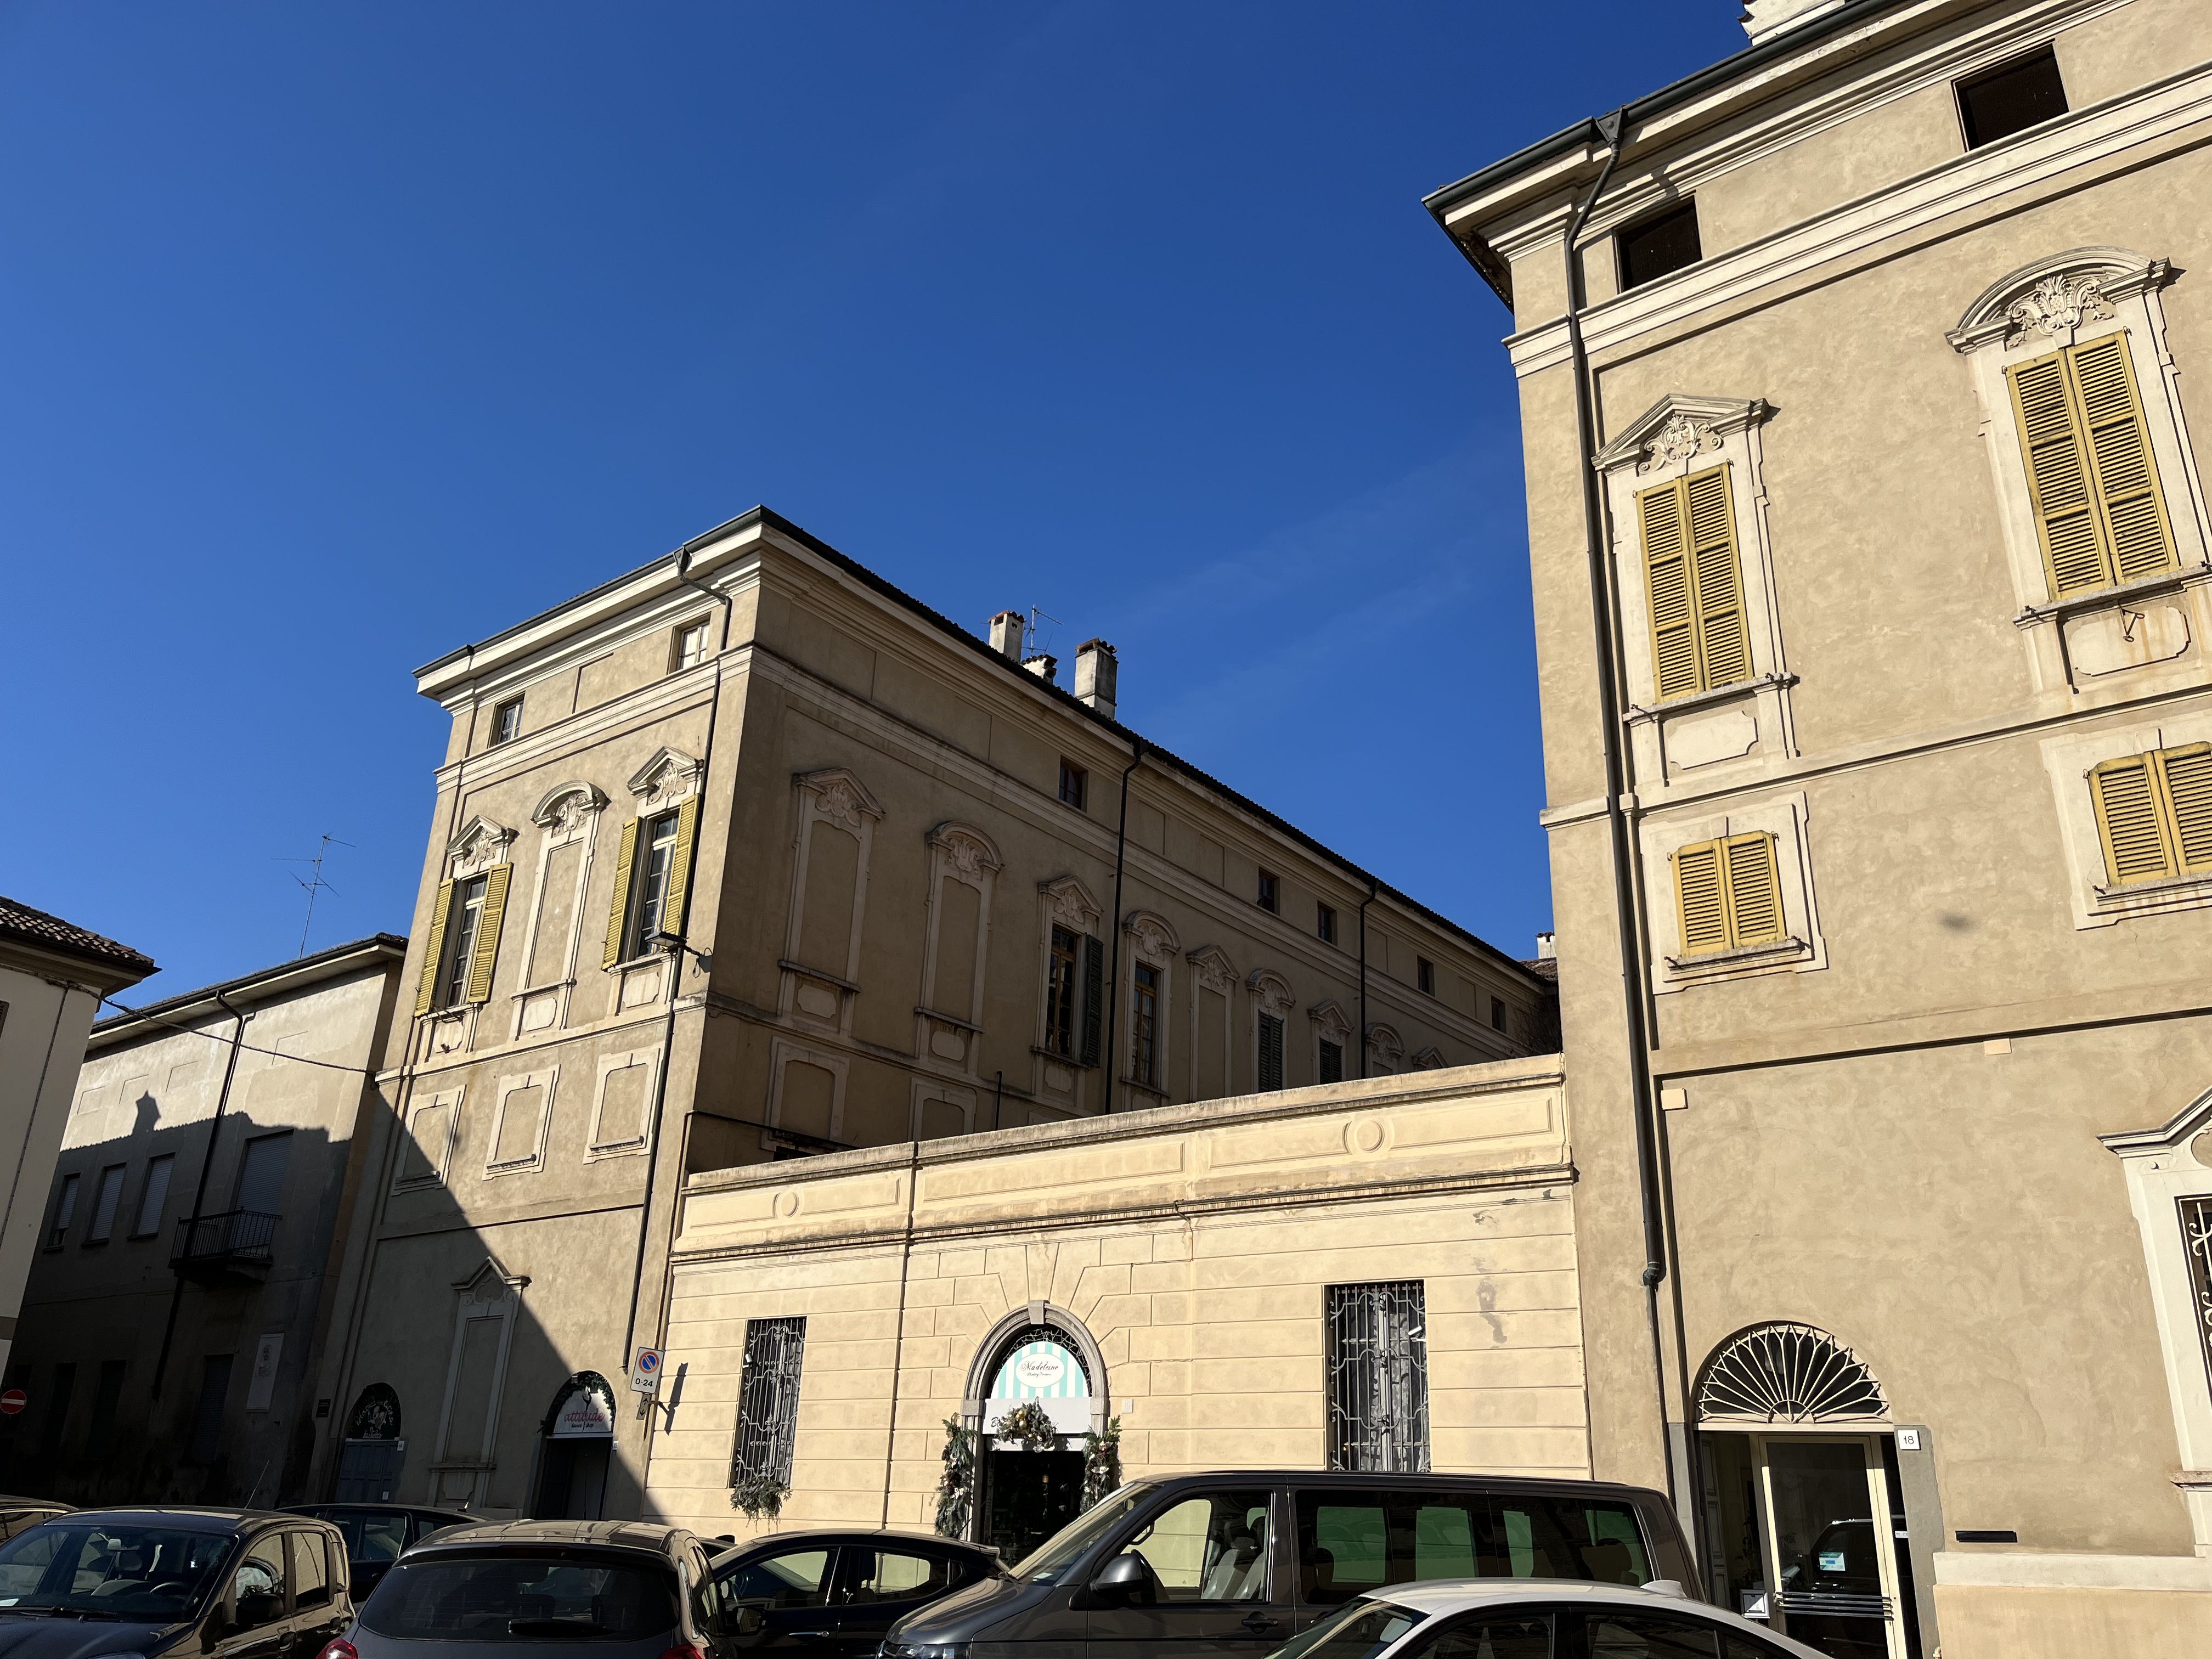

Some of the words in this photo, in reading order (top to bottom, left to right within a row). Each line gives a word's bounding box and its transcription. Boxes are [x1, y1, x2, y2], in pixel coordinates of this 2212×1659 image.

[1020, 1361, 1058, 1371] Madeleine
[635, 1378, 653, 1387] 0-24
[565, 1408, 605, 1422] attitude
[1903, 1436, 1914, 1444] 18
